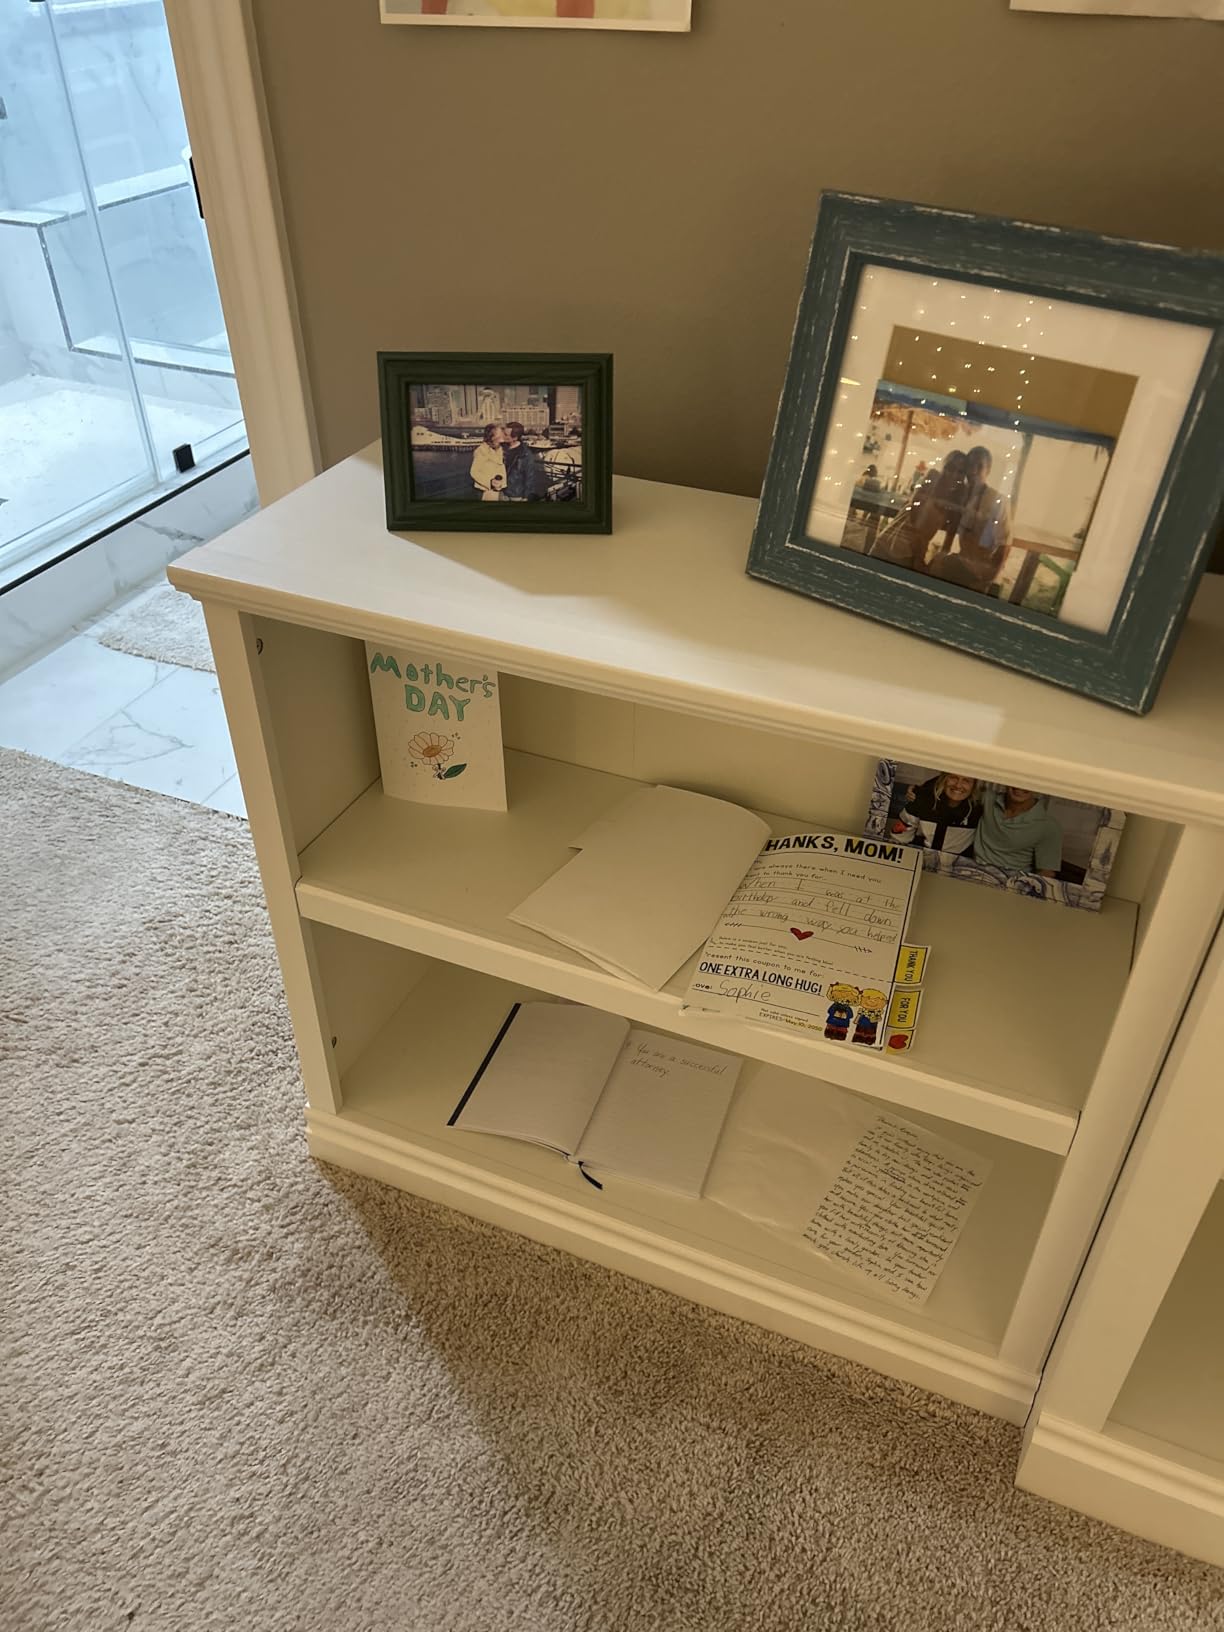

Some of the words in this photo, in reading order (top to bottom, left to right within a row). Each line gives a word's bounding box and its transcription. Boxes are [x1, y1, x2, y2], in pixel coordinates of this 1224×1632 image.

[370, 652, 496, 698] Mother's
[404, 684, 471, 721] DAY
[764, 835, 839, 853] HANKS,
[844, 838, 904, 863] MOM!
[847, 872, 866, 880] need
[791, 897, 816, 907] and
[864, 909, 893, 926] down
[753, 959, 780, 968] coupon
[906, 951, 918, 969] THANK
[699, 961, 724, 974] ONE
[723, 965, 759, 980] EXTRA
[762, 971, 794, 988] LONG
[794, 978, 823, 995] HUG!
[904, 968, 914, 982] YOU
[719, 978, 771, 1003] Sophie
[899, 997, 911, 1010] FOR
[897, 1010, 909, 1023] YOU
[630, 1058, 670, 1078] attorney
